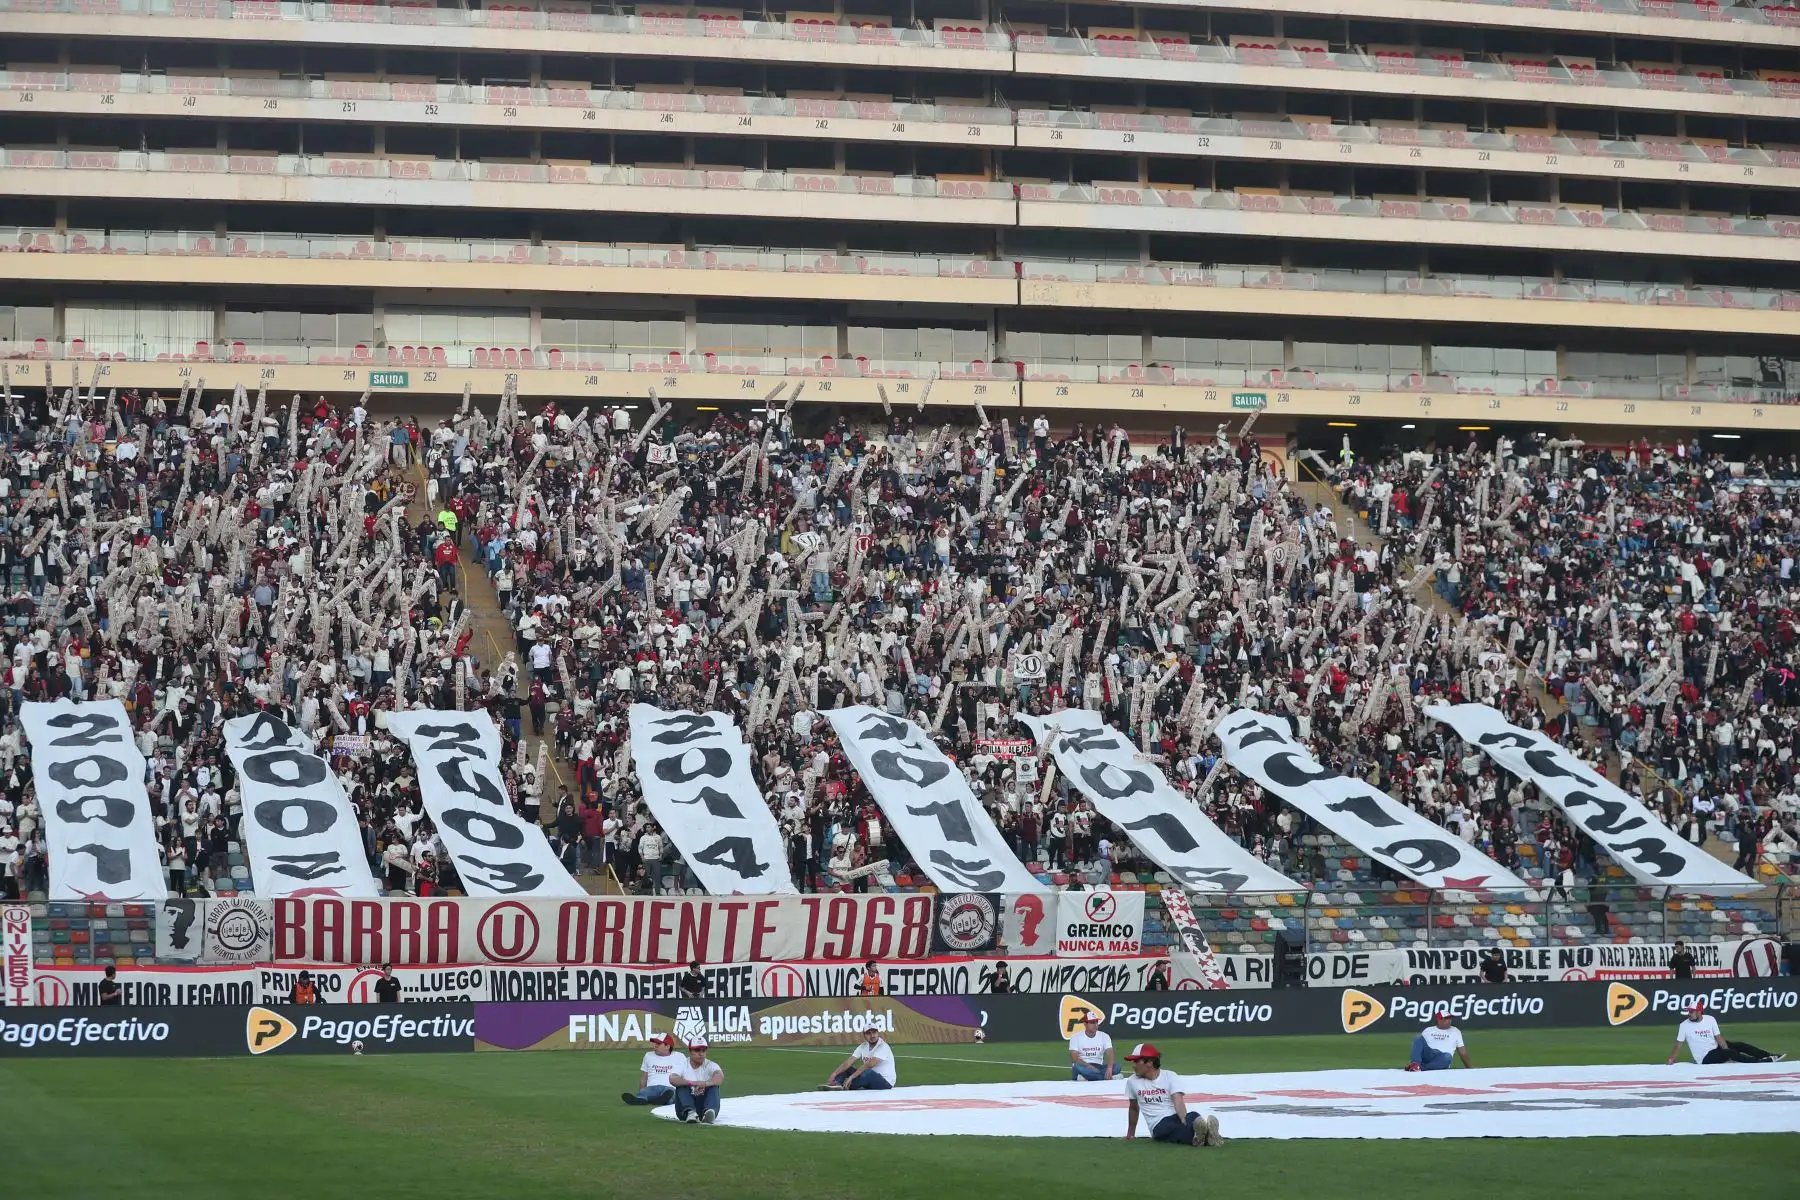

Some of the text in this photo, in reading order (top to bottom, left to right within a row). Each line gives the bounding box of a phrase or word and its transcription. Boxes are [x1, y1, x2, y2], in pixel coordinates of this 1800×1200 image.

[19, 92, 34, 102] 243
[100, 95, 114, 104] 245
[182, 97, 196, 107] 247
[263, 99, 277, 109] 249
[342, 102, 356, 112] 251
[424, 105, 438, 115] 252
[503, 108, 517, 117] 250
[582, 110, 596, 120] 248
[660, 114, 674, 123] 246
[738, 117, 752, 127] 244
[815, 120, 828, 129] 242
[892, 123, 905, 133] 240
[967, 127, 981, 136] 238
[1050, 130, 1063, 140] 236
[1198, 138, 1210, 147] 232
[1270, 141, 1282, 150] 230
[1340, 144, 1352, 154] 228
[1409, 148, 1421, 157] 226
[1478, 151, 1490, 161] 224
[1546, 155, 1558, 165] 222
[1613, 159, 1625, 168] 220
[1743, 167, 1754, 176] 216
[261, 368, 275, 378] 249
[423, 372, 437, 382] 252
[373, 374, 404, 385] SALIDA
[1056, 386, 1068, 396] 236
[1131, 388, 1144, 398] 234
[1204, 391, 1217, 400] 232
[1235, 396, 1262, 406] SALIDA
[1277, 393, 1290, 403] 230
[1348, 395, 1361, 405] 228
[1623, 403, 1635, 413] 220
[208, 900, 230, 924] BARRA
[243, 899, 267, 923] ORIENTE
[275, 898, 459, 964] BARRA
[556, 900, 779, 964] ORIENTE
[800, 896, 931, 960] 1968
[1067, 924, 1133, 938] GREMCO
[1059, 938, 1139, 952] NUNCA MÁS
[1559, 948, 1593, 968] NO
[1599, 946, 1625, 966] NACI
[1628, 946, 1654, 966] PARA
[1332, 954, 1370, 979] DE
[490, 966, 570, 1002] MORIRÉ
[576, 970, 618, 1000] POR
[1040, 964, 1130, 994] IMPORTAS
[117, 982, 171, 1005] EJOR
[1390, 993, 1544, 1022] PagoEfectivo
[708, 1005, 752, 1032] LIGA
[1110, 1000, 1272, 1029] PagoEfectivo
[0, 1017, 170, 1047] agoEfectivo
[569, 1014, 654, 1042] FINAL
[708, 1033, 752, 1042] FEMENINA
[1137, 1088, 1166, 1096] apuesta
